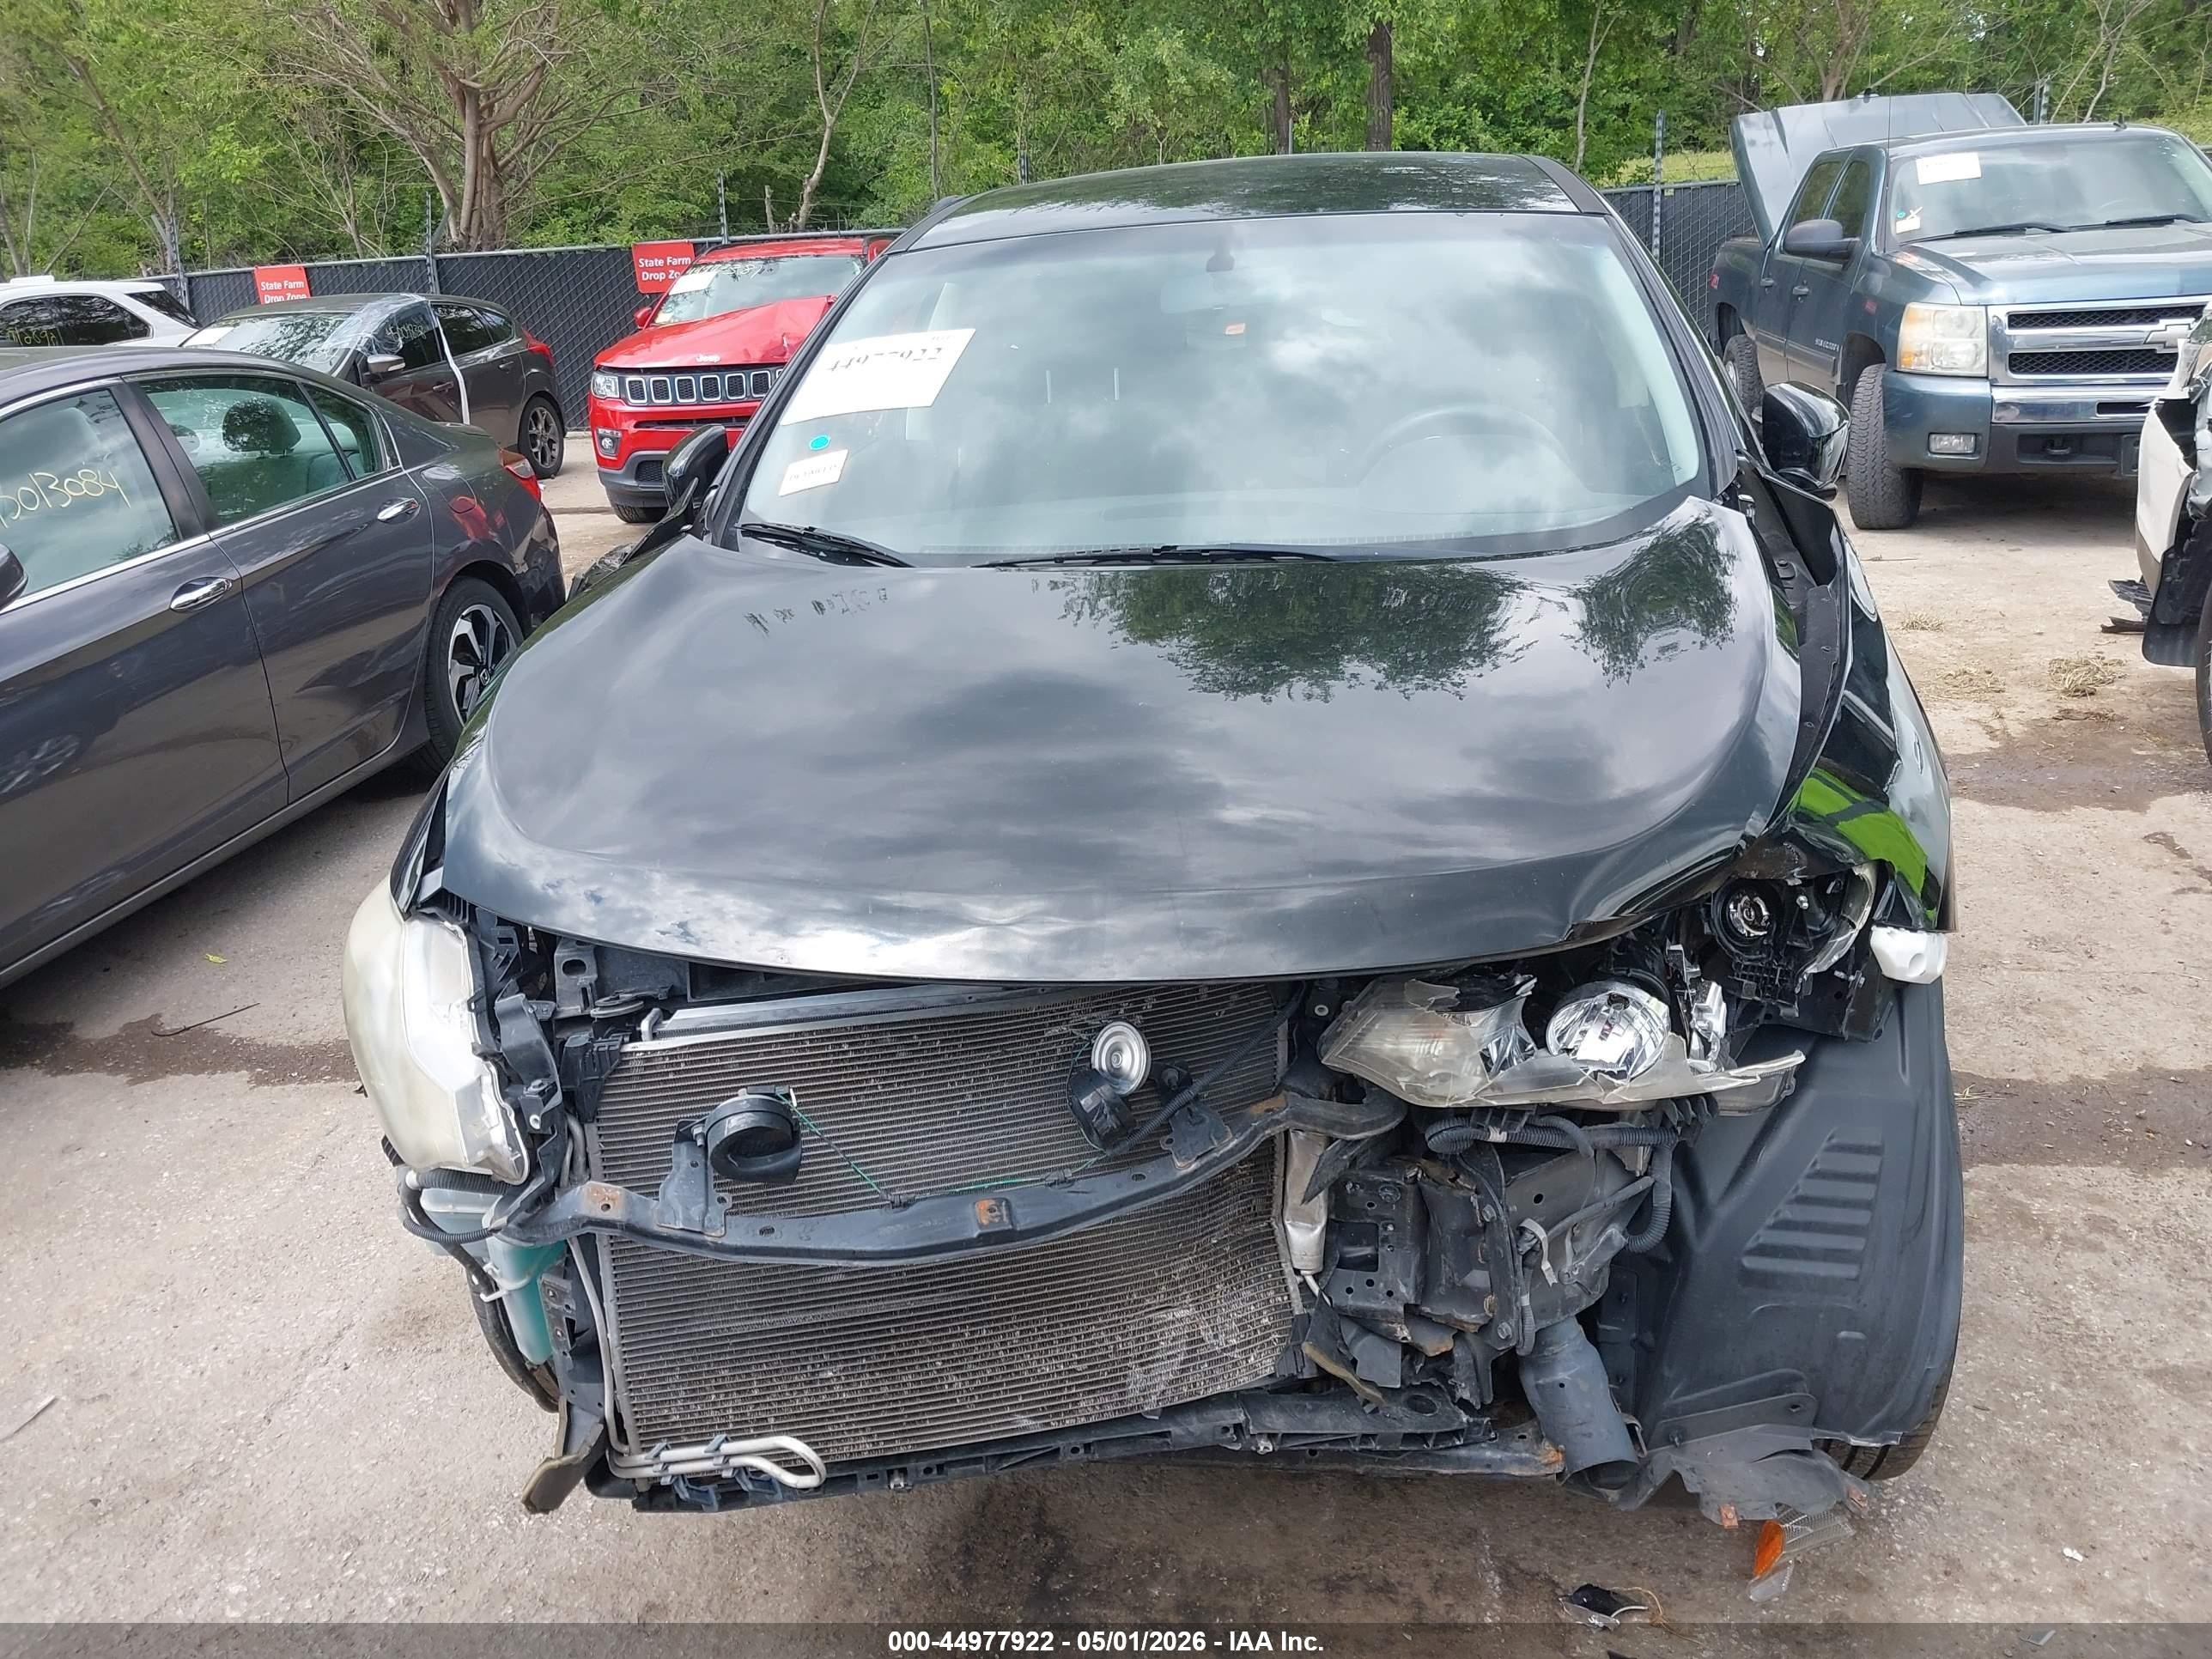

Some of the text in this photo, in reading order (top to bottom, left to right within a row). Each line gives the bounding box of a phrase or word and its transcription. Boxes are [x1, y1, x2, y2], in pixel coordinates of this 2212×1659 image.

[638, 256, 691, 268] State Farm
[641, 270, 666, 283] Drop
[260, 280, 305, 291] State Farm
